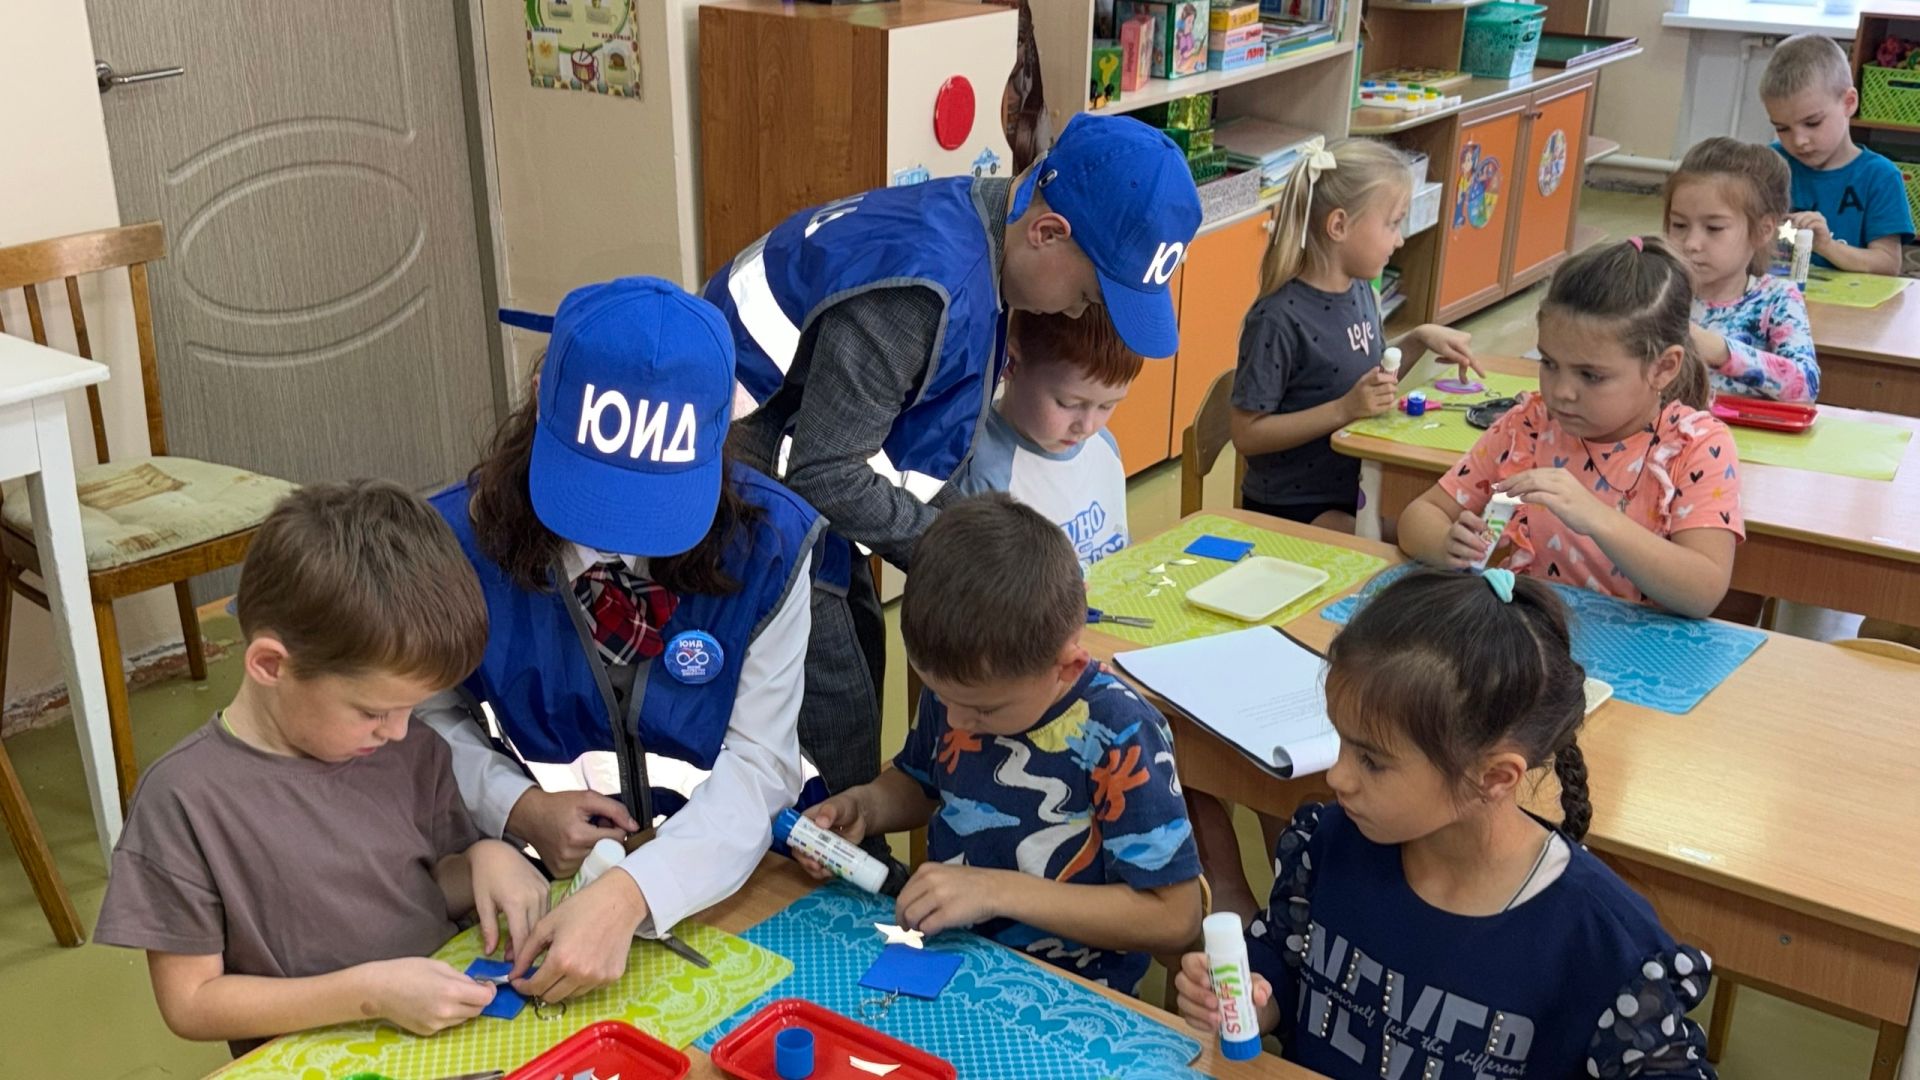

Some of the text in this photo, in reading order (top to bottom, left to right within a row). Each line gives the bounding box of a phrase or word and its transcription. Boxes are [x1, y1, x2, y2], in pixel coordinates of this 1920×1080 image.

[577, 383, 696, 463] ЮИД
[679, 639, 703, 648] ЮИД
[1324, 986, 1527, 1076] yourself feel the different
